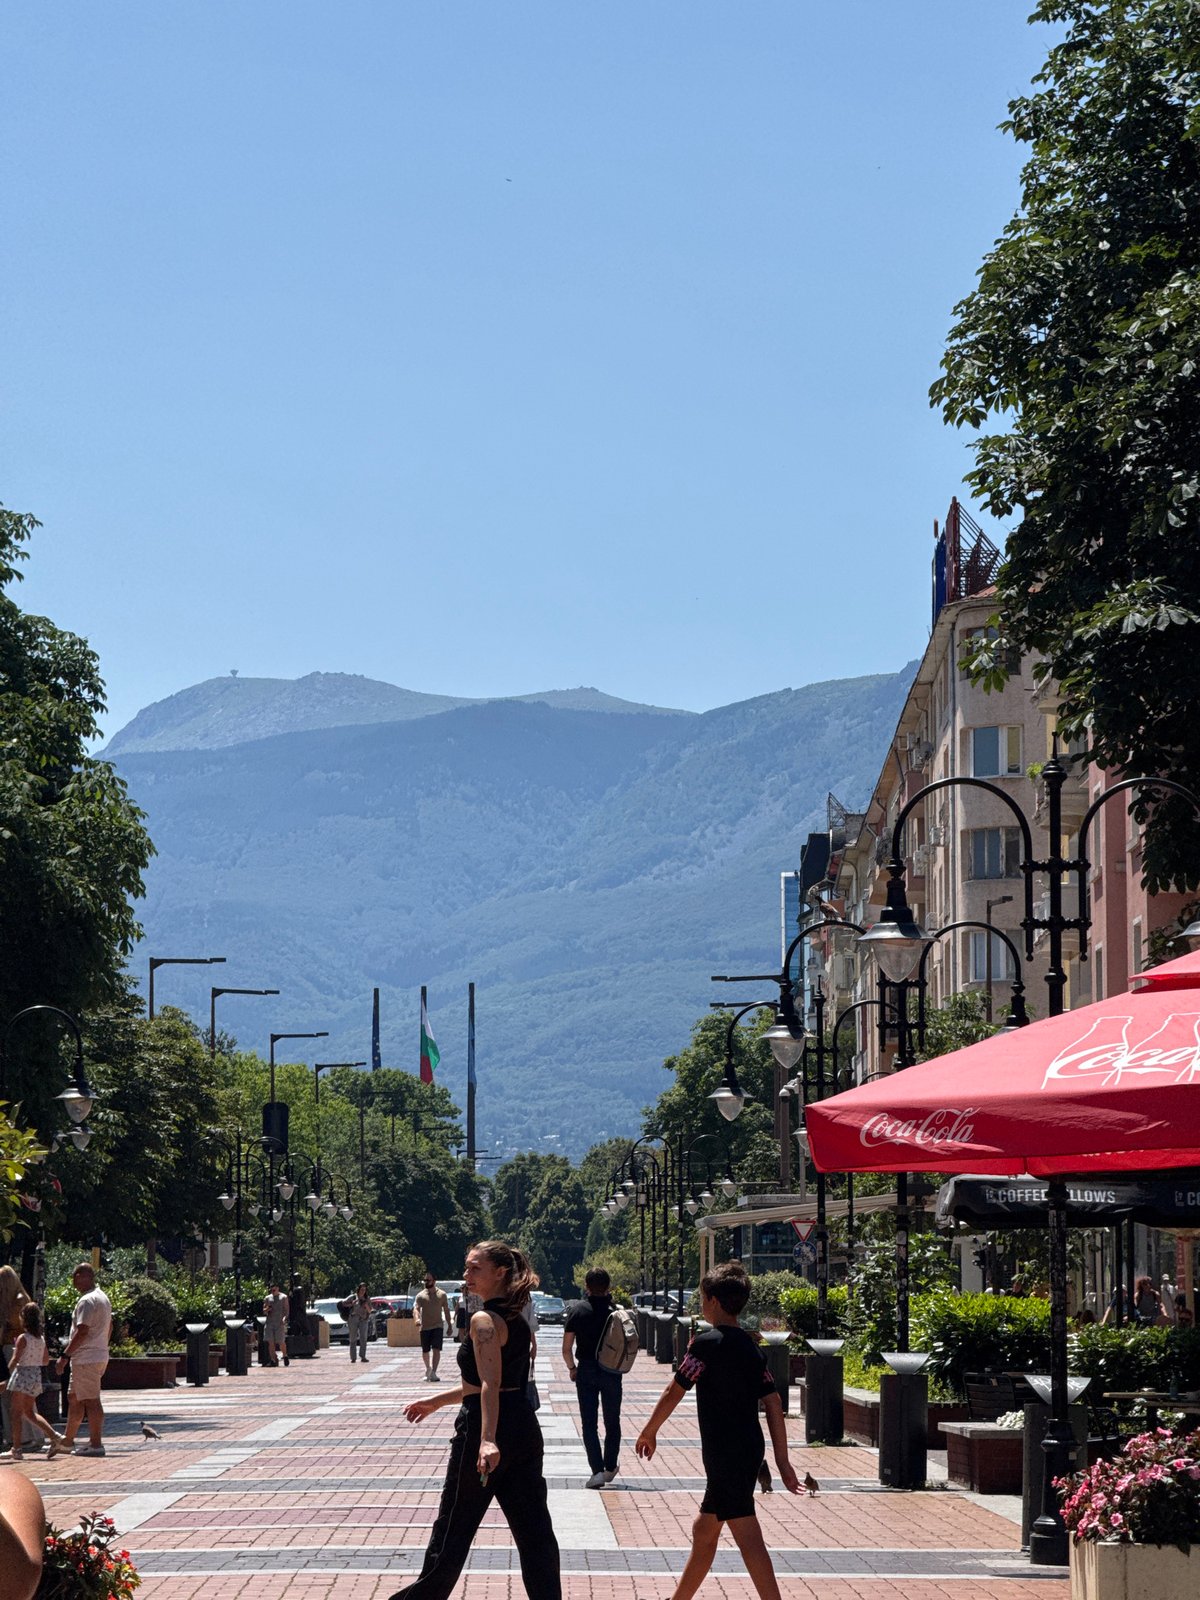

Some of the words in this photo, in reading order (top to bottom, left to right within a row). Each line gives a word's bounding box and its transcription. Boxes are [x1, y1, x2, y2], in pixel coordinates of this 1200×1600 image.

[1045, 1041, 1200, 1079] Coca
[859, 1106, 982, 1147] Coca-Cola
[998, 1188, 1049, 1203] COFFEE
[1064, 1188, 1116, 1204] LLOWS
